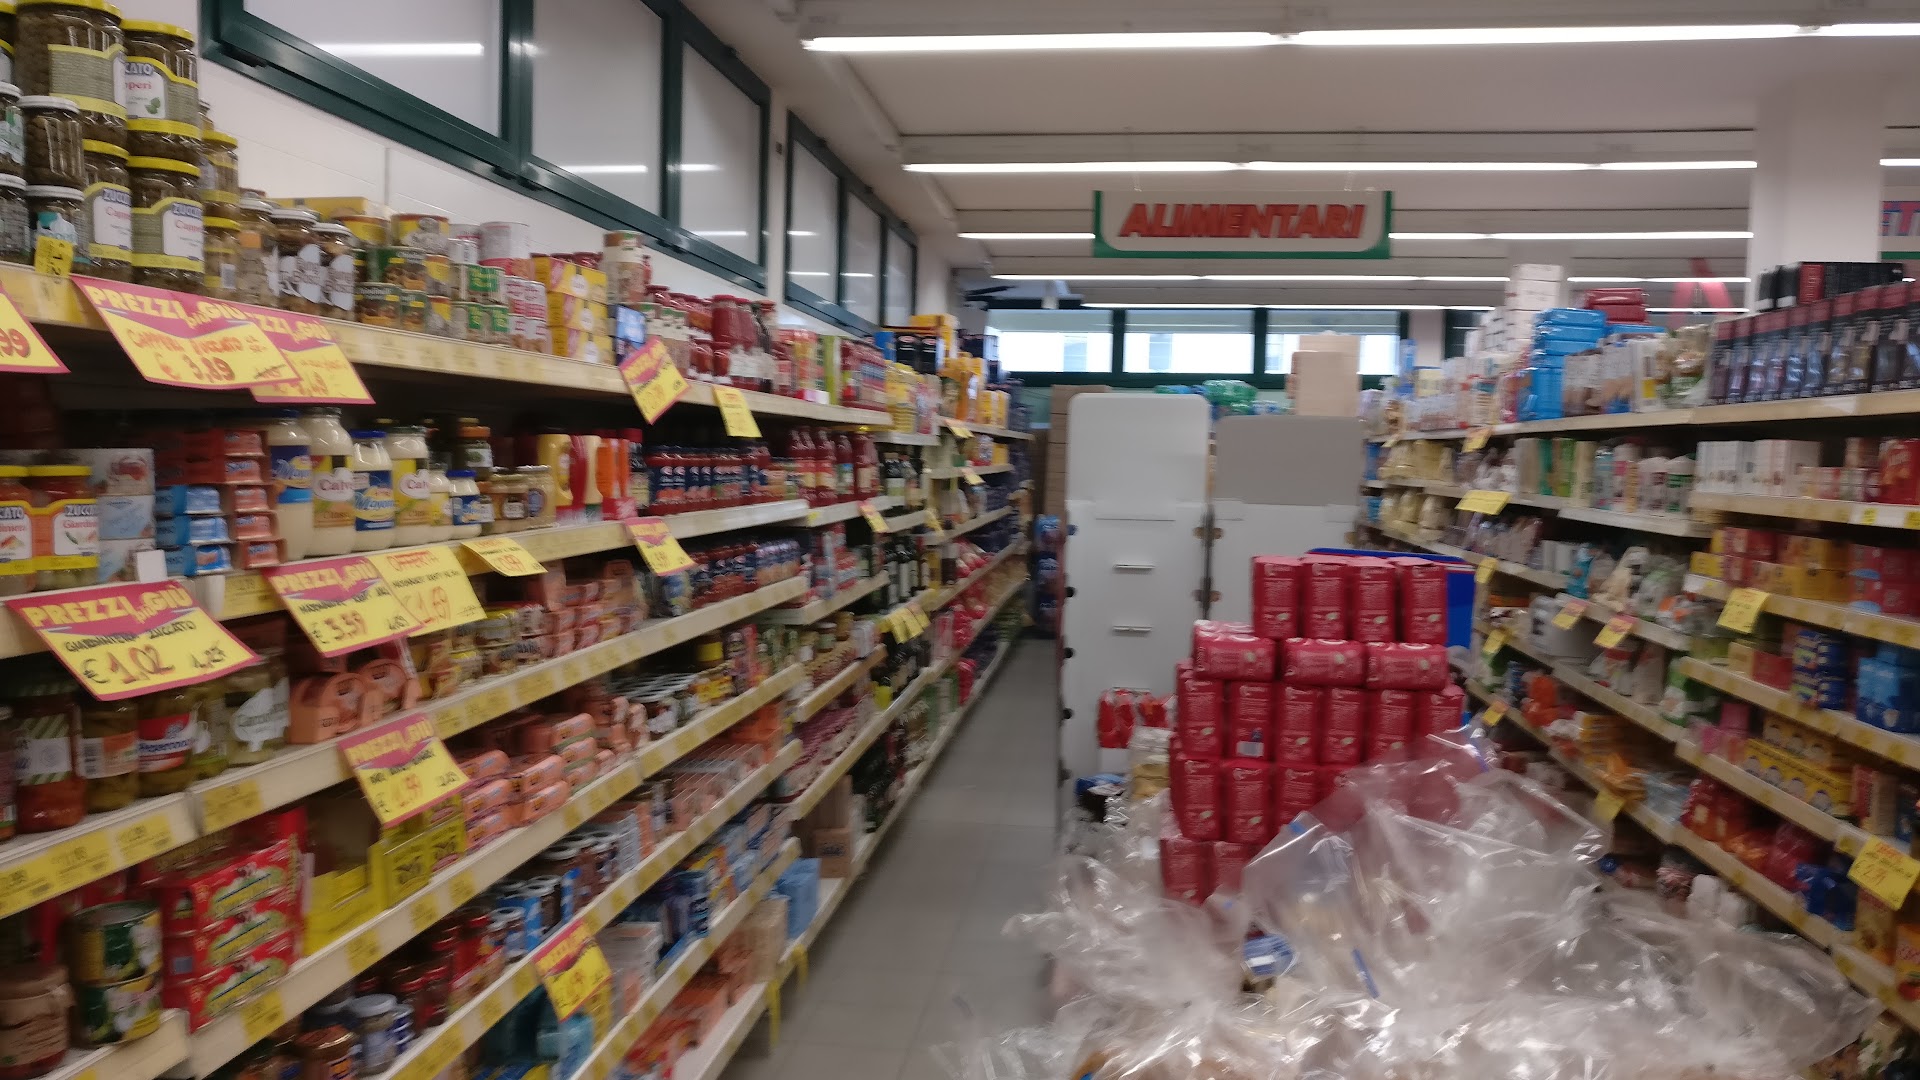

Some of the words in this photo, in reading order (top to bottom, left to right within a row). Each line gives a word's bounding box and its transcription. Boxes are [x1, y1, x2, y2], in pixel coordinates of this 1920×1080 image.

[1118, 203, 1365, 238] ALIMENTARI
[84, 285, 186, 320] PREZZI
[22, 594, 138, 628] PREZZI
[142, 583, 194, 610] GIÙ
